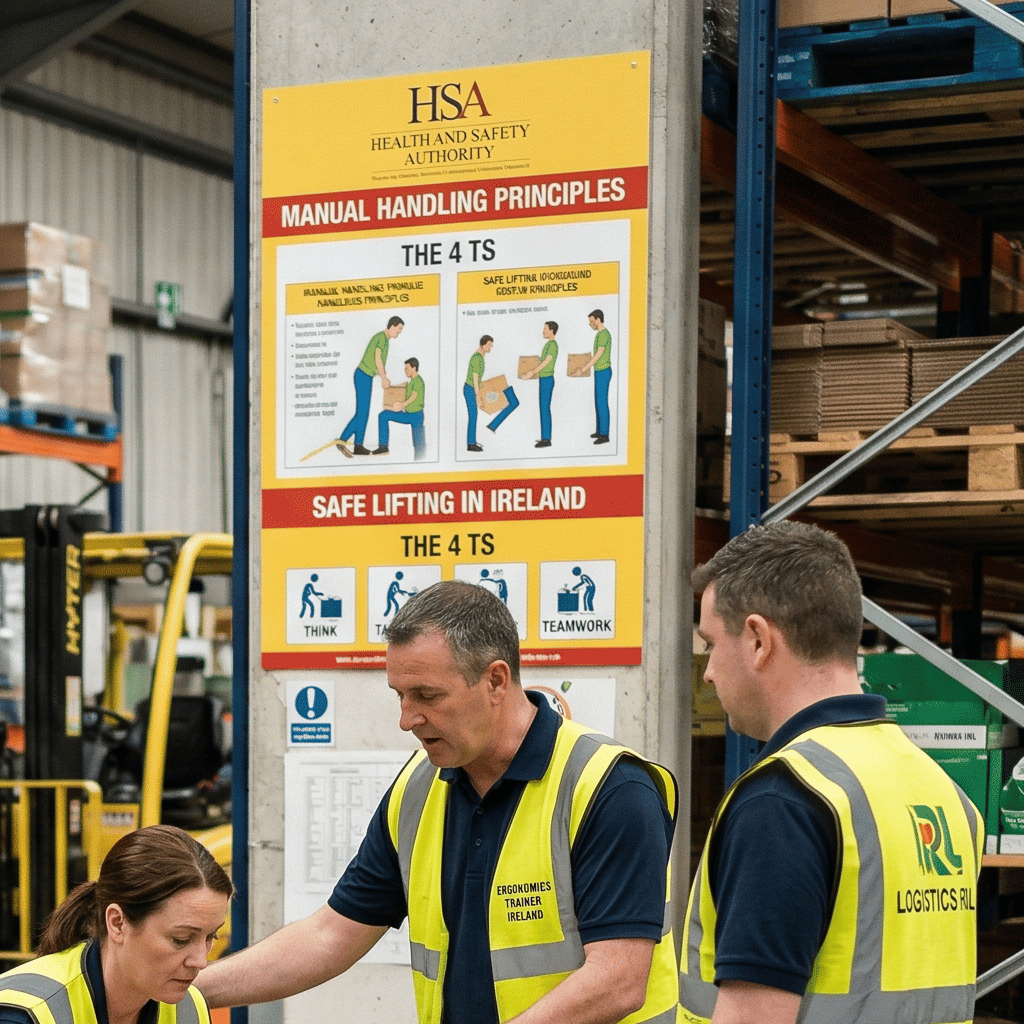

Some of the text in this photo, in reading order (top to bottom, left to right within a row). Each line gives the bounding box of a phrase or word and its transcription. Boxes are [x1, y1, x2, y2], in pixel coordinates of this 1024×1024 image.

[408, 81, 492, 124] HSA
[371, 124, 531, 151] HEALTH AND SAFETY
[404, 146, 494, 166] AUTHORITY
[281, 177, 626, 228] MANUAL HANDLING PRINCIPLES
[401, 239, 496, 267] THE 4 TS
[483, 275, 504, 285] SAFE
[312, 486, 587, 518] SAFE LIFTING IN IRELAND
[400, 533, 495, 557] THE 4 TS
[304, 625, 337, 637] THINK
[542, 620, 612, 633] TEAMWORK
[504, 896, 543, 909] TRAINER
[897, 888, 958, 914] LOGISTICS
[507, 909, 544, 922] IRELAND
